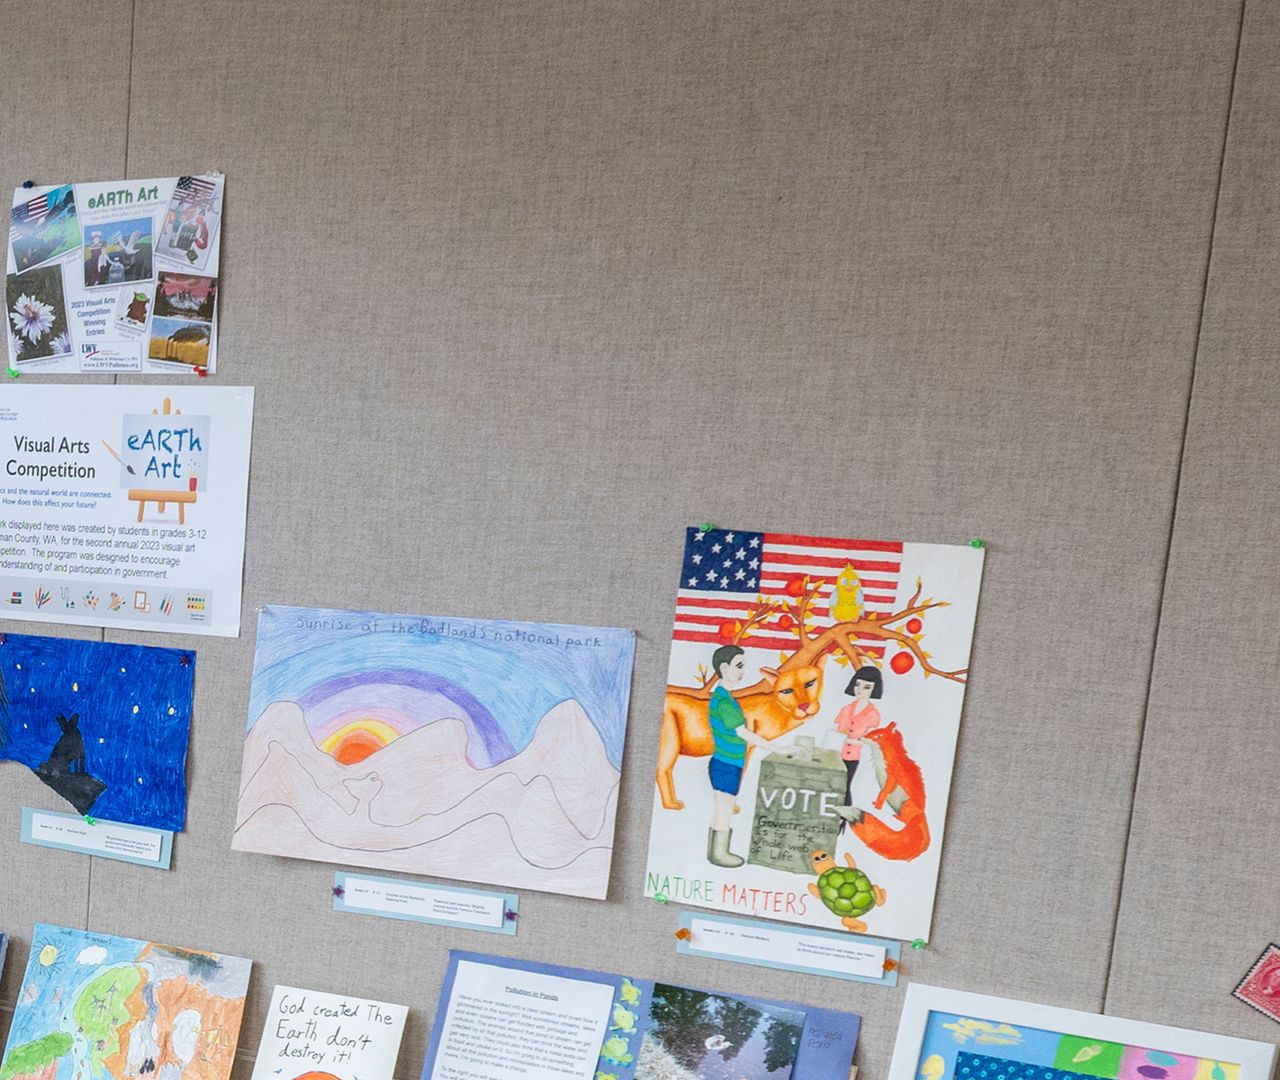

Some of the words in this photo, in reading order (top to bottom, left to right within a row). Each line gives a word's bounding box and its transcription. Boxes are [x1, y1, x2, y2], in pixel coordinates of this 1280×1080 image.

[138, 186, 159, 202] Art
[14, 436, 55, 453] Visual
[58, 437, 90, 453] Arts
[127, 428, 202, 451] eARTh
[6, 459, 96, 481] Competition
[144, 455, 181, 478] Art
[8, 521, 41, 532] displayed
[44, 523, 59, 531] here
[61, 524, 76, 532] was
[78, 525, 105, 534] created
[108, 526, 116, 536] by
[118, 527, 150, 536] students
[152, 528, 158, 536] in
[160, 529, 186, 539] grades
[188, 529, 207, 539] 3-12
[60, 536, 70, 545] for
[72, 537, 84, 546] the
[85, 539, 112, 548] second
[114, 540, 139, 549] annual
[140, 540, 159, 550] 2023
[162, 543, 183, 552] visual
[185, 544, 195, 552] art
[32, 548, 45, 557] The
[47, 549, 77, 560] program
[79, 552, 94, 560] was
[96, 552, 130, 564] designed
[131, 555, 139, 563] to
[140, 556, 181, 568] encourage
[44, 562, 52, 570] of
[54, 564, 67, 572] and
[69, 564, 112, 576] participation
[114, 567, 121, 575] in
[122, 568, 168, 579] government.
[296, 617, 353, 631] Sunrise
[362, 619, 379, 633] at
[391, 620, 414, 634] the
[418, 618, 486, 639] Badlands
[494, 630, 560, 646] national
[565, 638, 601, 652] park
[760, 787, 839, 817] VOTE
[647, 871, 714, 903] NATURE
[723, 884, 809, 916] MATTERS
[505, 986, 533, 997] Pollution
[540, 992, 559, 1001] Ponds
[279, 993, 308, 1015] God
[313, 1002, 359, 1019] created
[368, 1003, 394, 1026] The
[276, 1019, 318, 1042] Earth
[326, 1028, 372, 1051] don't
[278, 1042, 324, 1063] destroy
[332, 1049, 351, 1064] it!
